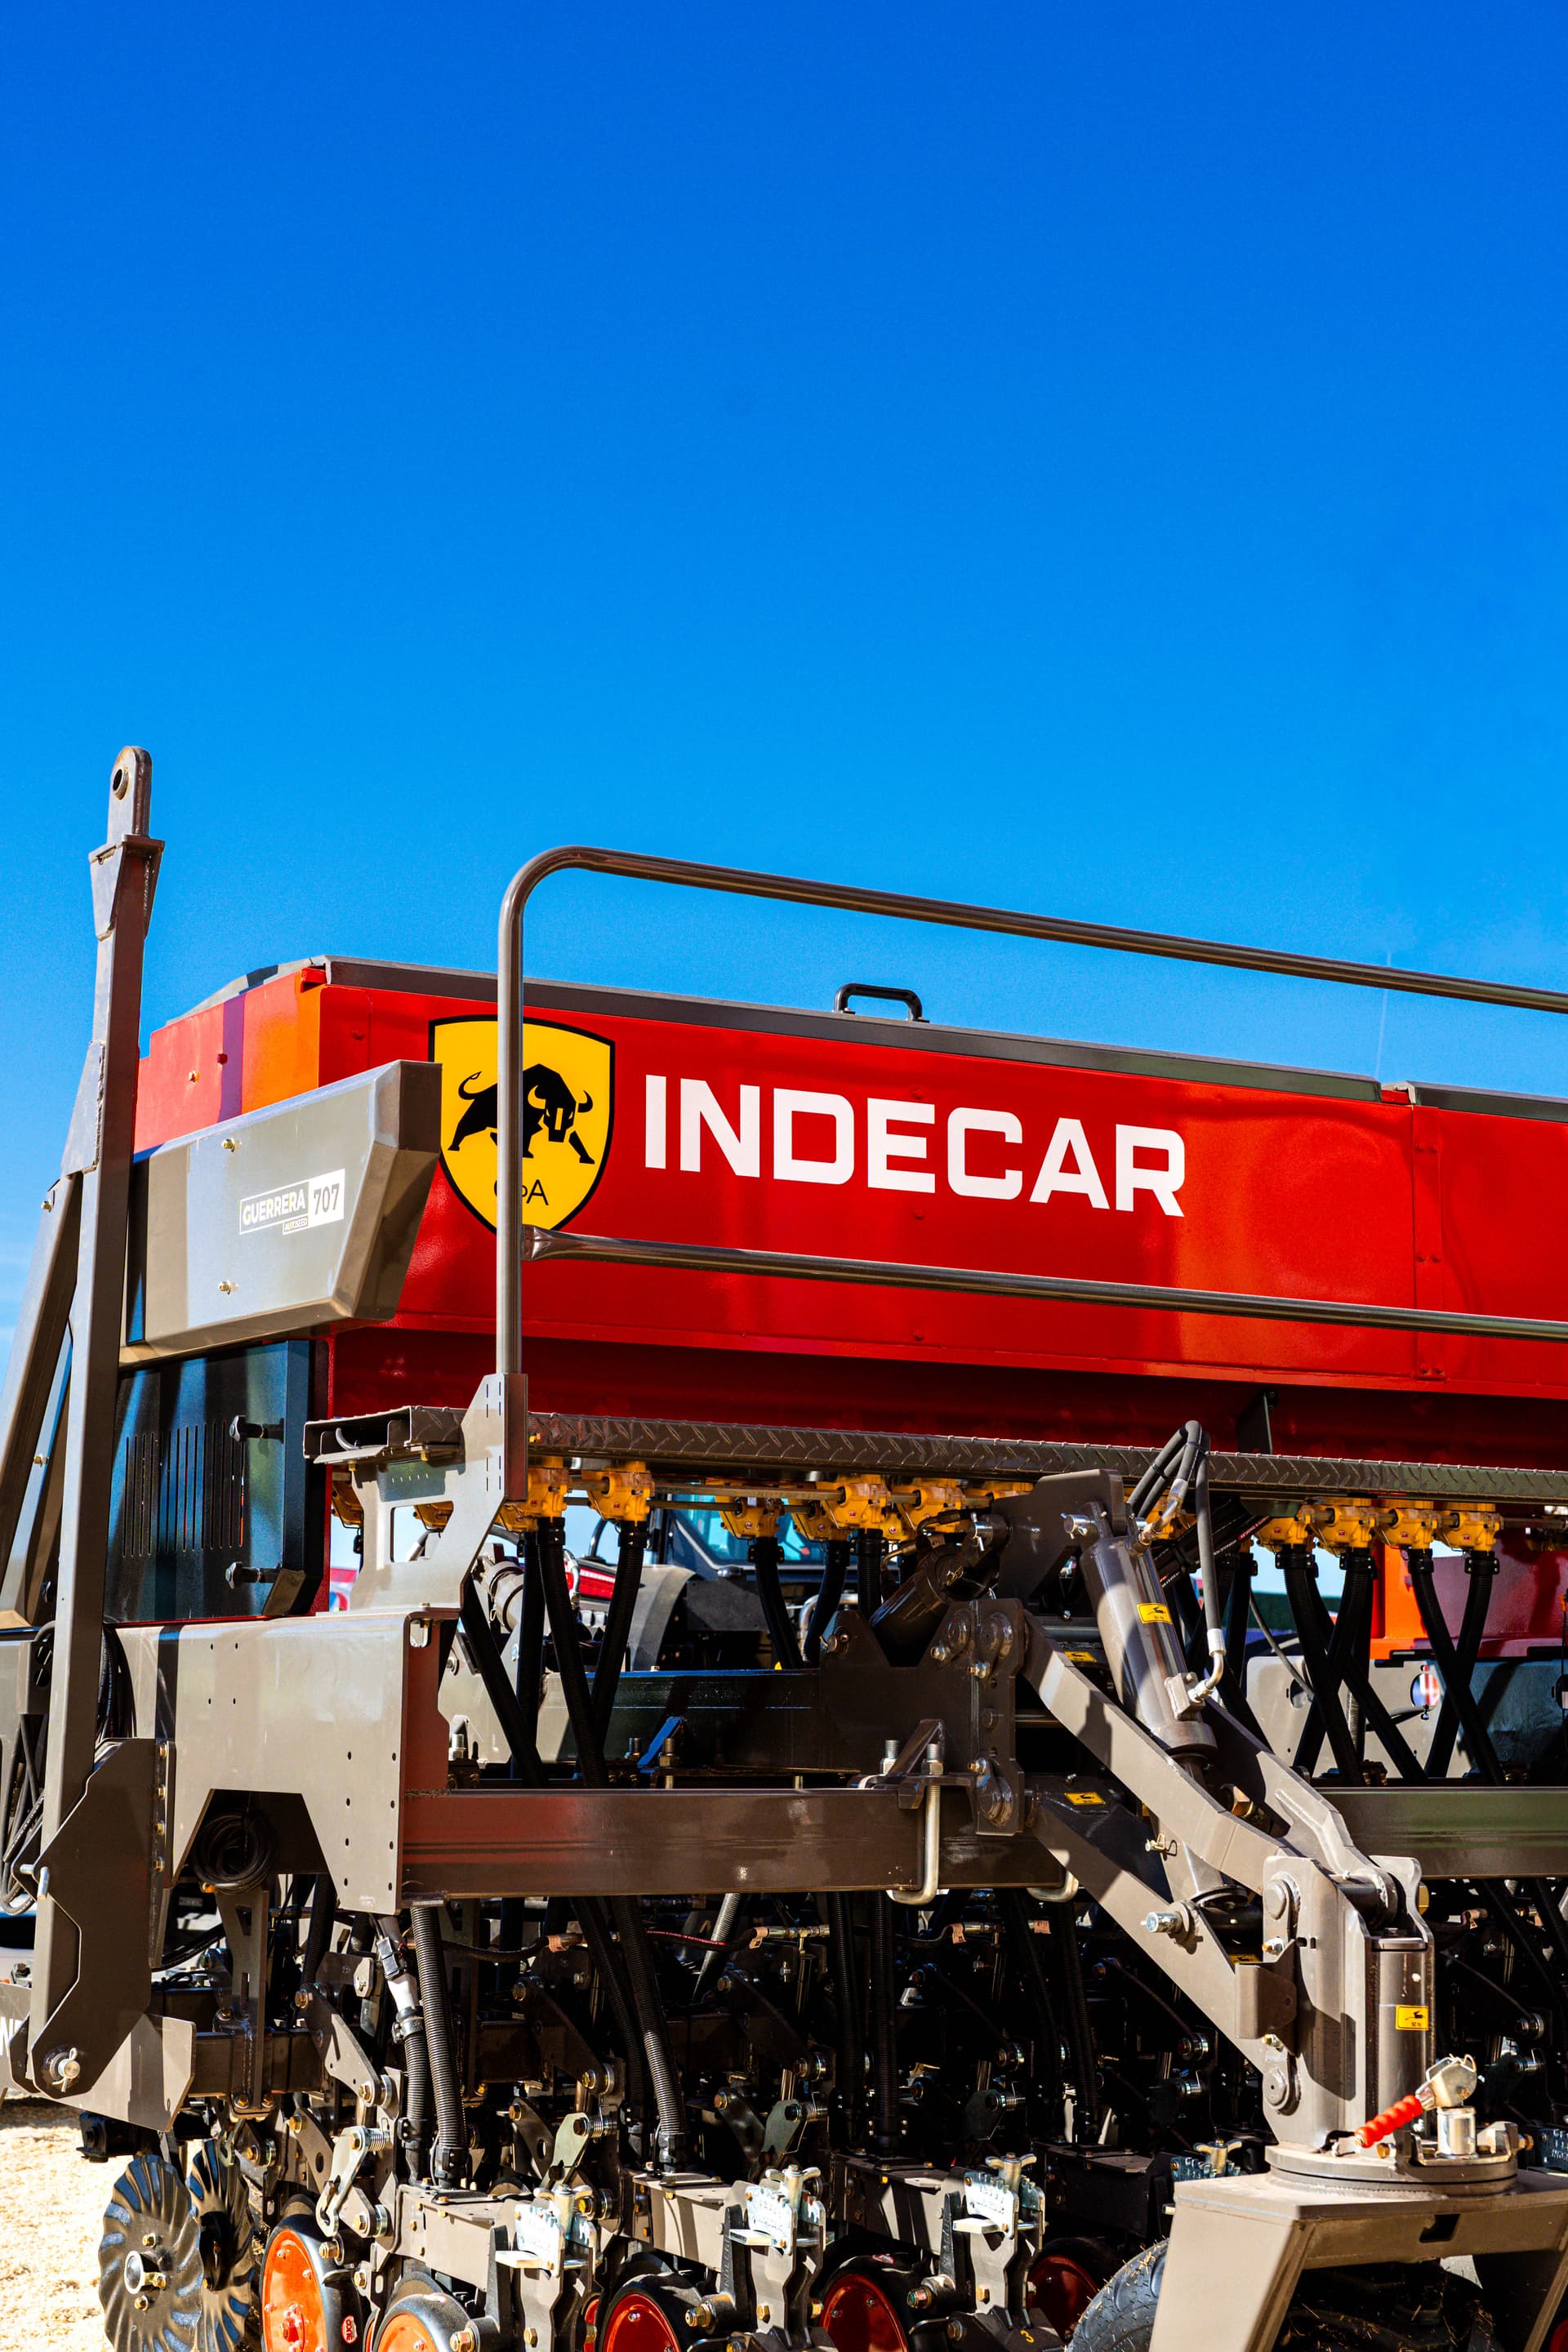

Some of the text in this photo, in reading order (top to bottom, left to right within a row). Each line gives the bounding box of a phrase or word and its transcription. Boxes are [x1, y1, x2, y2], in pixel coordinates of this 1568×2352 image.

[645, 1075, 1186, 1217] INDECAR
[243, 1183, 340, 1226] GUERRERA 707
